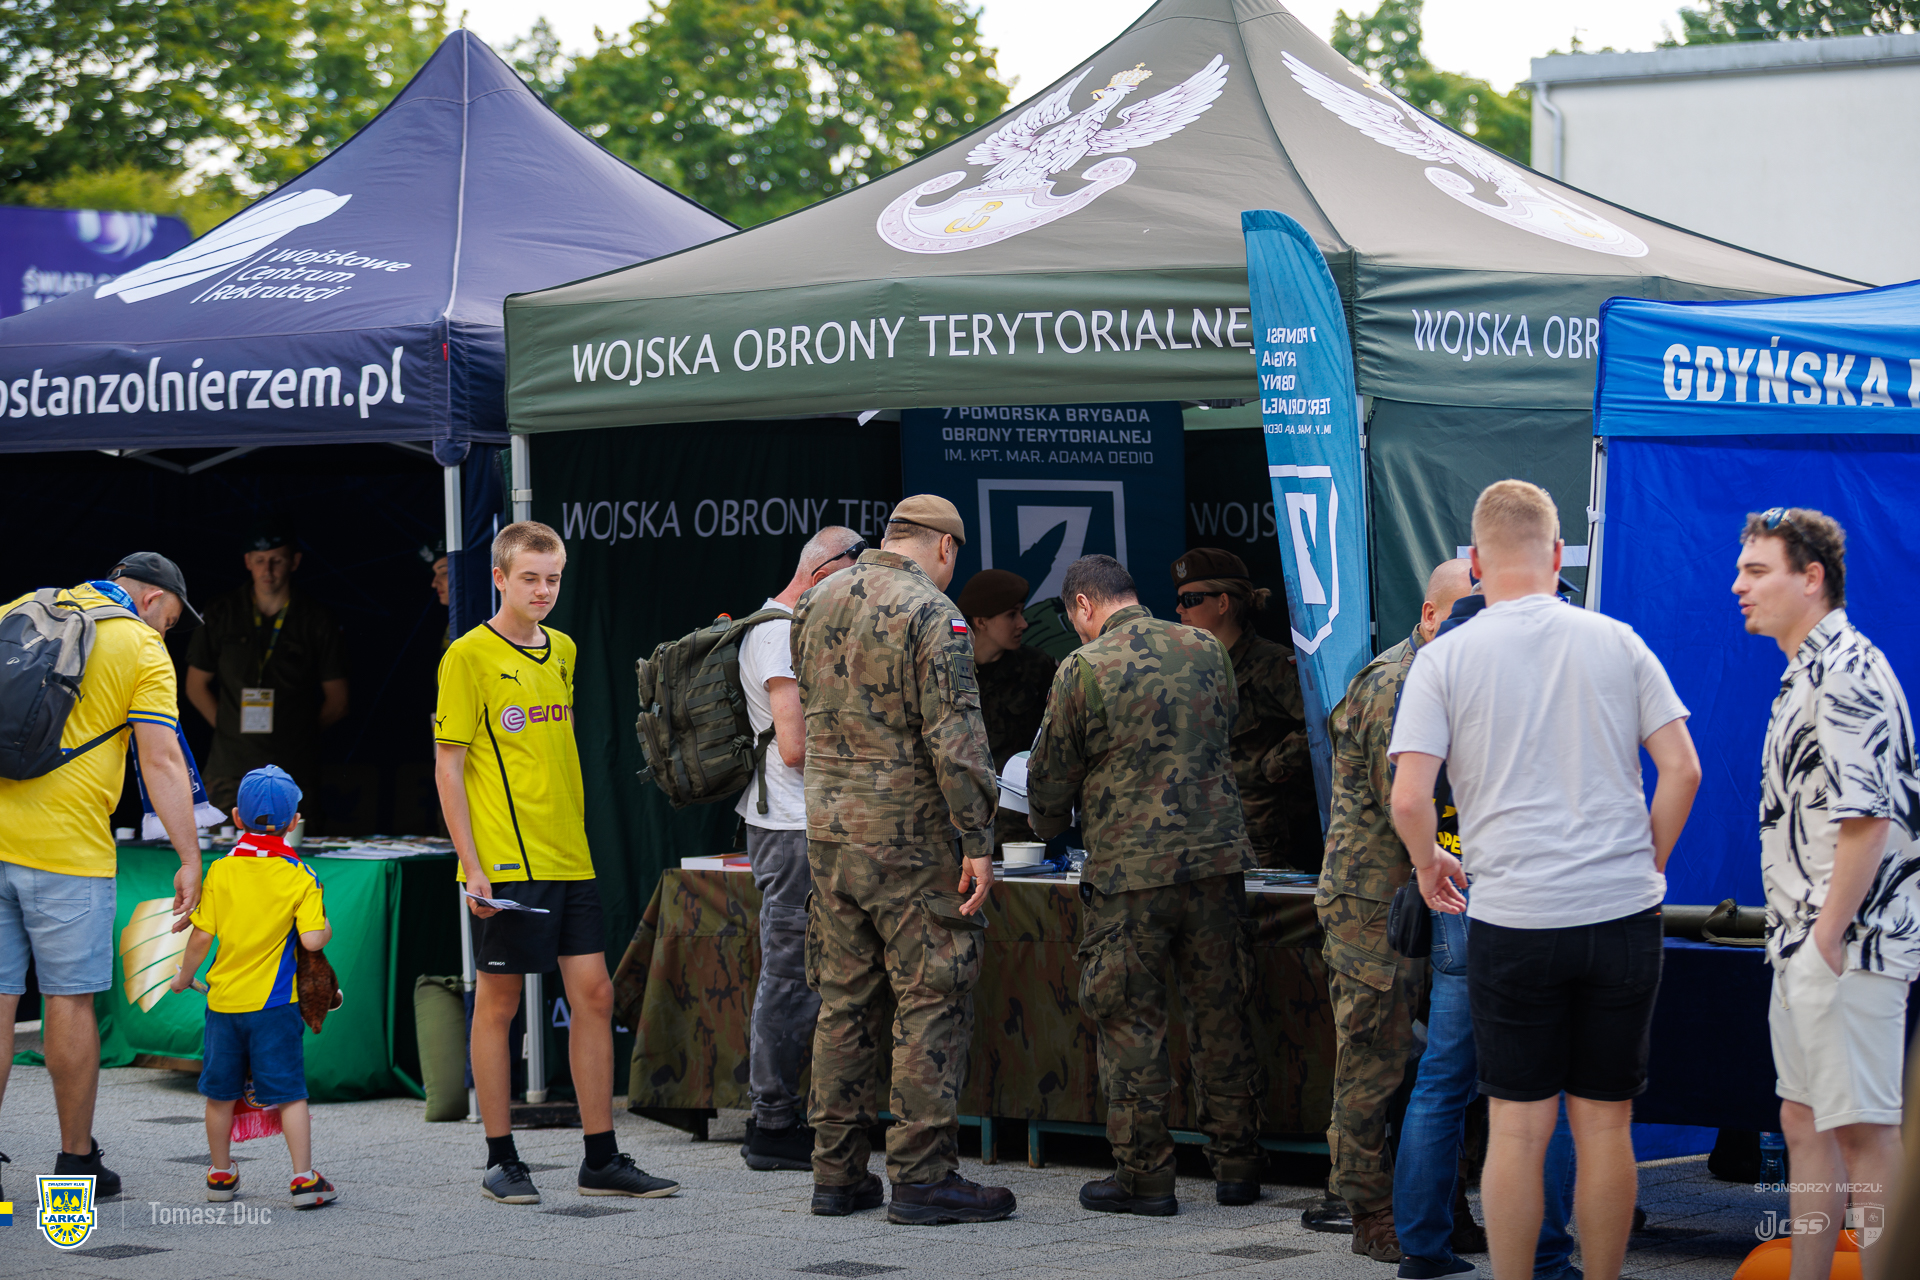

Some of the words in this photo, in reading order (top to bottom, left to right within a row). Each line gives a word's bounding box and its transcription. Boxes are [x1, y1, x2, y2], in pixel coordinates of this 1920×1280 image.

[268, 249, 412, 272] Wojskowe
[236, 265, 356, 283] Centrum
[202, 281, 352, 303] Rekrutacji
[572, 333, 720, 386] WOJSKA
[733, 316, 906, 371] OBRONY
[918, 307, 1256, 356] TERYTORIALNE
[1411, 309, 1534, 362] WOJSKA
[1543, 315, 1600, 359] OBR
[1663, 335, 1895, 408] GDYŃSKA
[942, 407, 953, 420] 7
[959, 407, 1060, 422] POMORSKA
[1066, 408, 1151, 423] BRYGADA
[942, 427, 1012, 442] OBRONY
[1016, 428, 1152, 444] TERYTORIALNEJ
[944, 449, 967, 461] IM.
[970, 449, 1003, 462] KPT.
[1006, 450, 1044, 463] MAR.
[1048, 451, 1105, 464] ADAMA
[1108, 451, 1154, 465] DEDIO
[562, 501, 681, 546] WOJSKA
[694, 497, 829, 538] OBRONY
[838, 498, 895, 536] TER
[1190, 501, 1277, 543] WOJS
